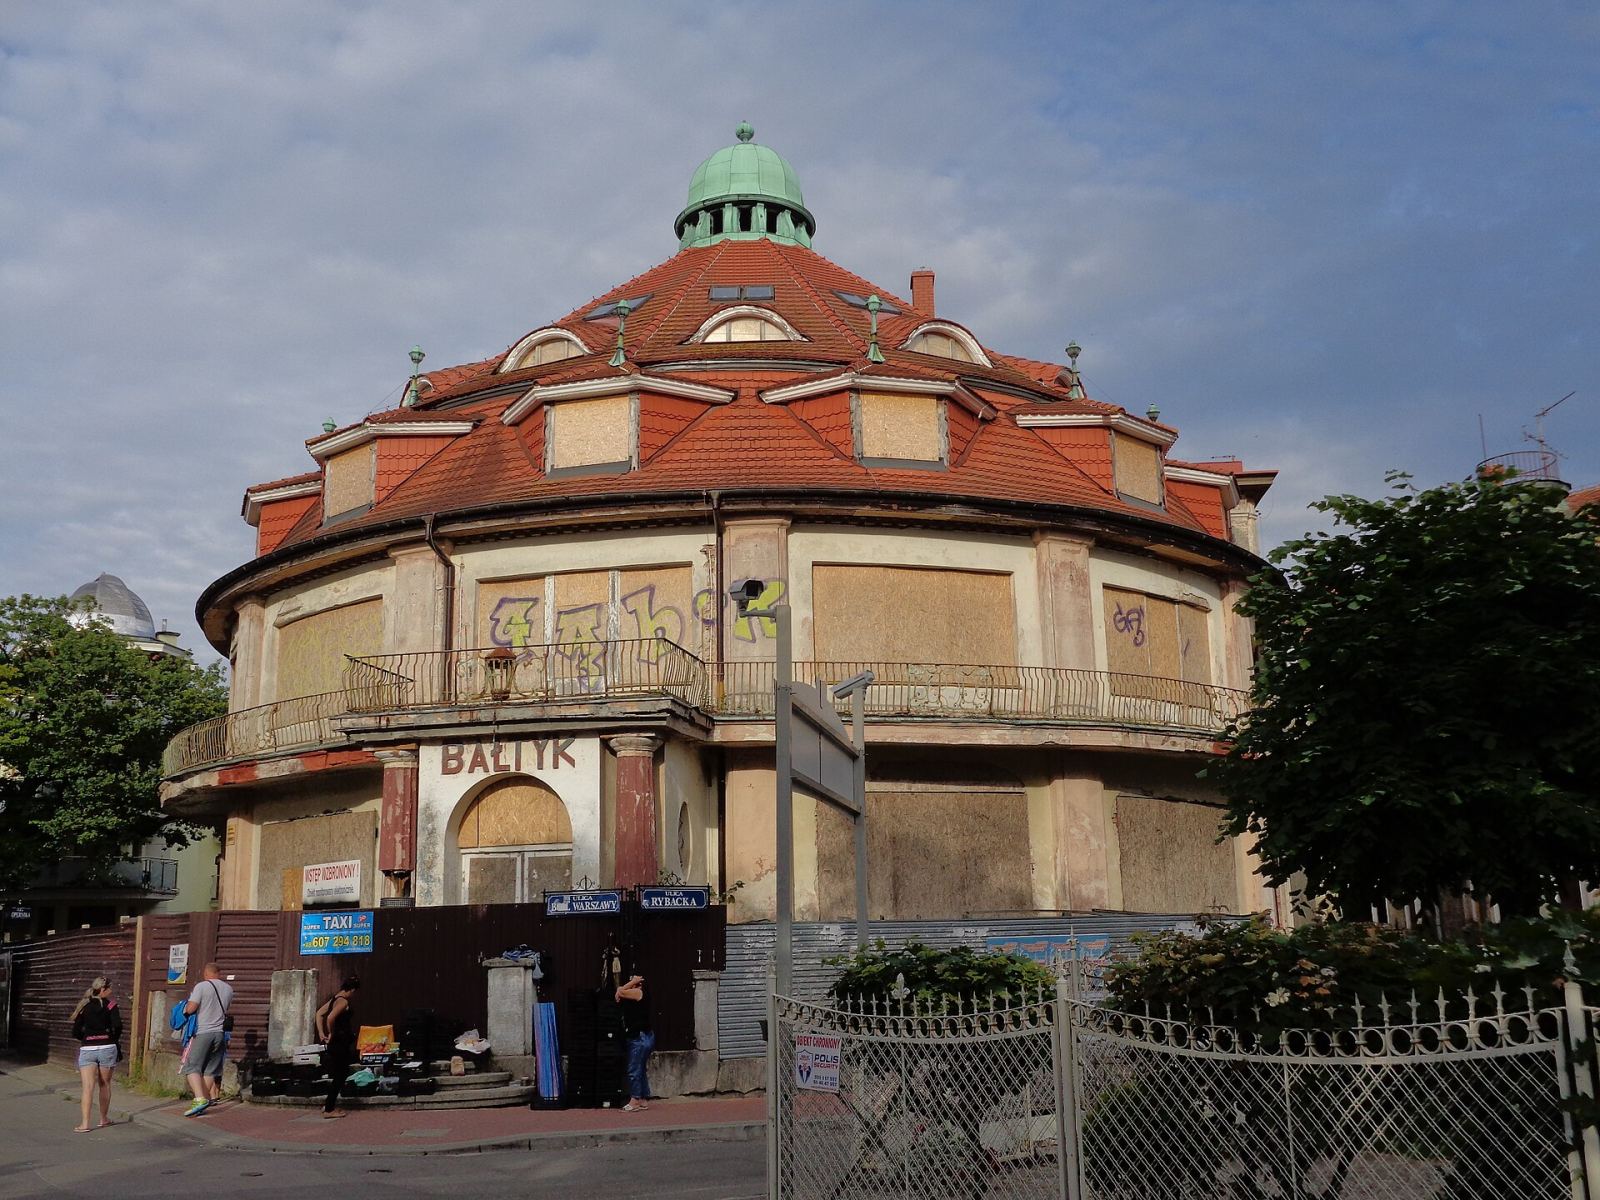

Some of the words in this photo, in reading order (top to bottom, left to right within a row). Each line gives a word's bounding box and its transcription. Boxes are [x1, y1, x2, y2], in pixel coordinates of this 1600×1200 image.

[305, 868, 321, 885] WSTĘP
[322, 864, 355, 881] WZBRONIONY
[573, 900, 617, 911] WARSZAWY
[651, 897, 697, 906] RYBACKA
[323, 915, 353, 930] TAXI
[312, 936, 330, 948] 607
[333, 935, 350, 947] 294
[352, 934, 371, 946] 818
[796, 1035, 812, 1046] OBIEKT
[813, 1037, 840, 1049] CHRONIONY
[814, 1054, 839, 1064] POLIS
[814, 1062, 838, 1070] SECURITY
